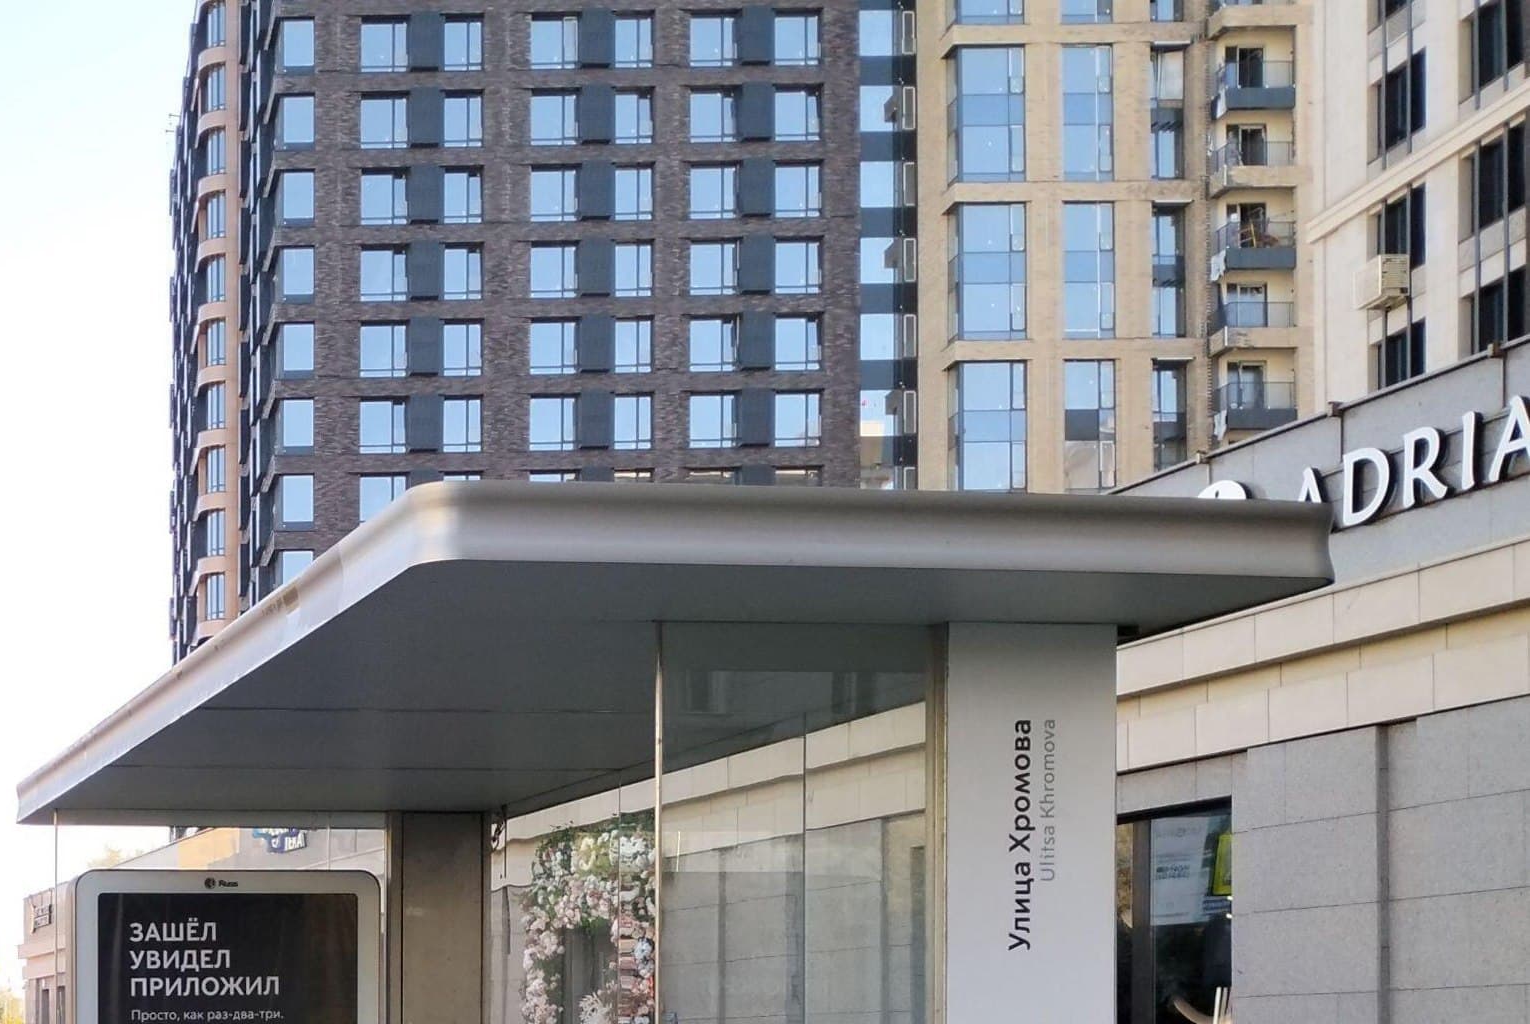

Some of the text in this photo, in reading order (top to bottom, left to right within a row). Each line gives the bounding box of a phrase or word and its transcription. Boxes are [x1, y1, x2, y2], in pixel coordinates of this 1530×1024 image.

[1039, 719, 1056, 881] Ulitsa Khromova
[1008, 719, 1036, 950] Улица Хромова
[129, 917, 217, 942] ЗАШЁЛ
[129, 949, 231, 972] УВИДЕЛ
[130, 976, 280, 997] ПРИЛОЖИЛ
[131, 1008, 284, 1022] Просто, как раз-два-три.
